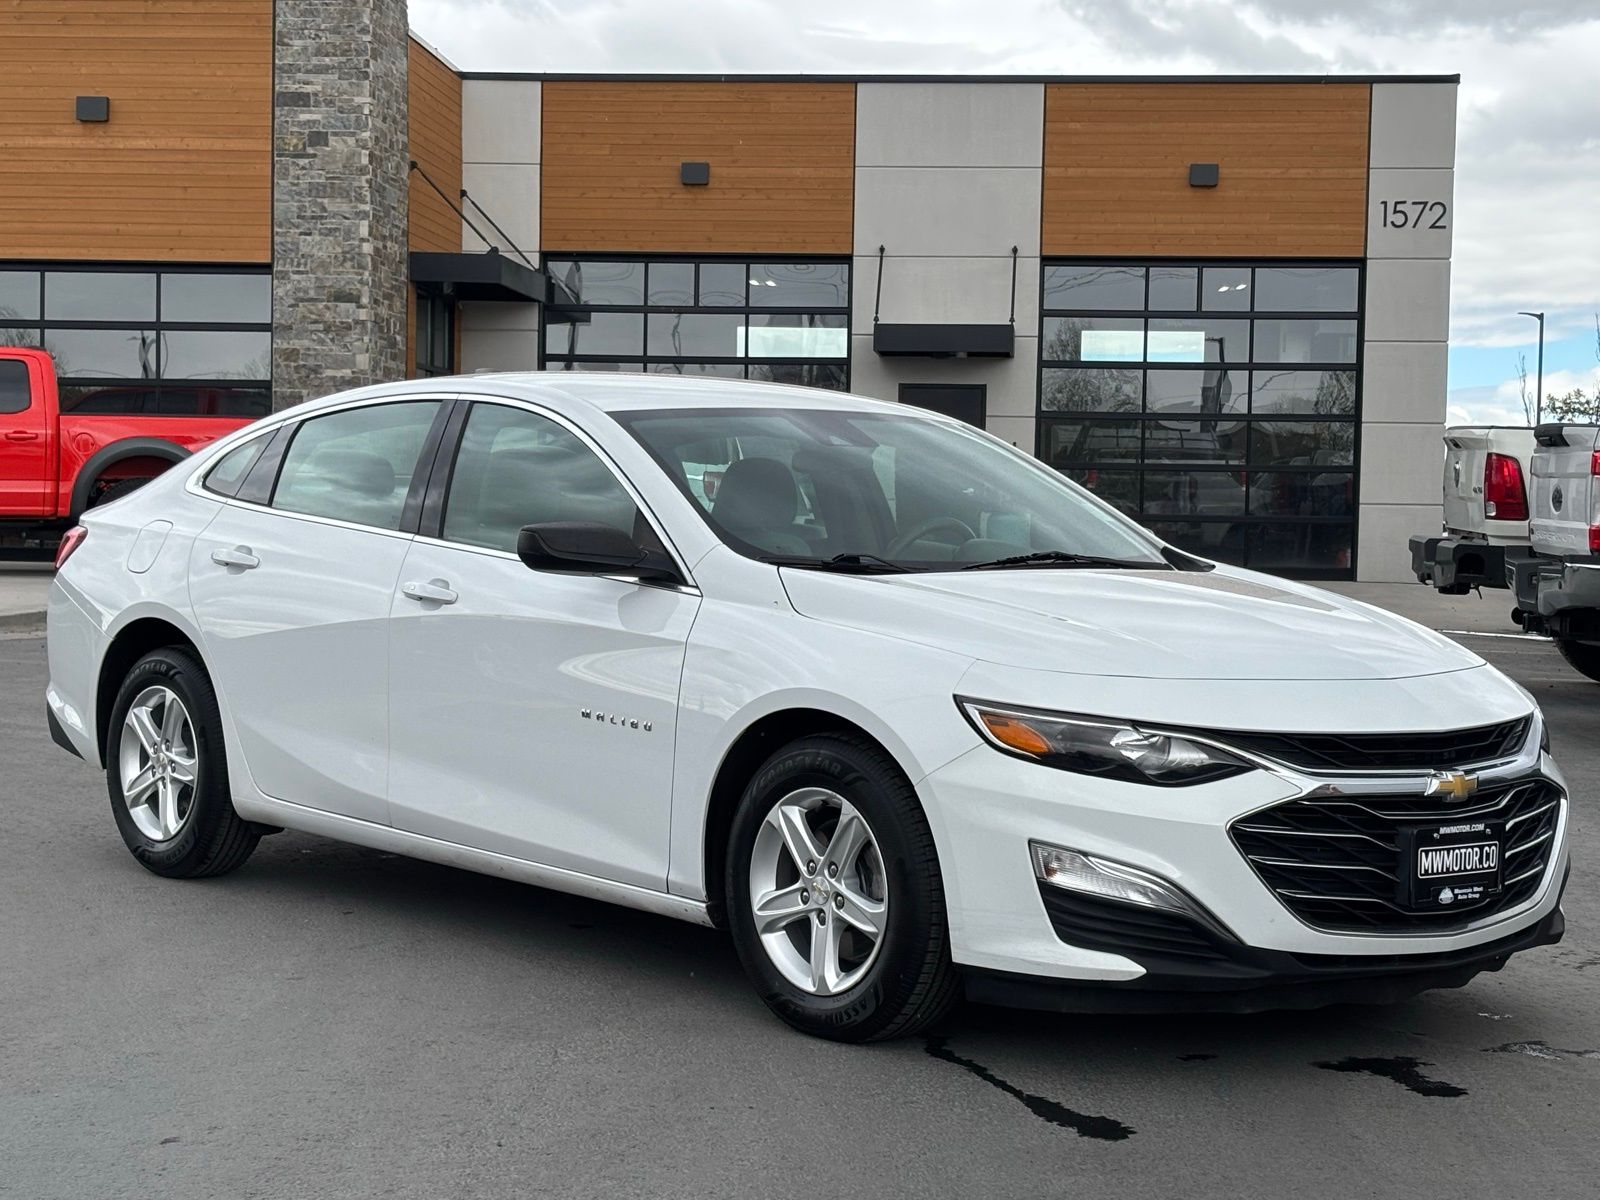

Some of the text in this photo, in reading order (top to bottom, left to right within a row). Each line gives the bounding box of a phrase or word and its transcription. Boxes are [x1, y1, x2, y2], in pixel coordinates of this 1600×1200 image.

[1380, 200, 1447, 229] 1572
[581, 708, 652, 732] MALIBU
[1439, 823, 1485, 834] MWMOTOR.COM
[1421, 845, 1497, 874] MWMOTOR.CO
